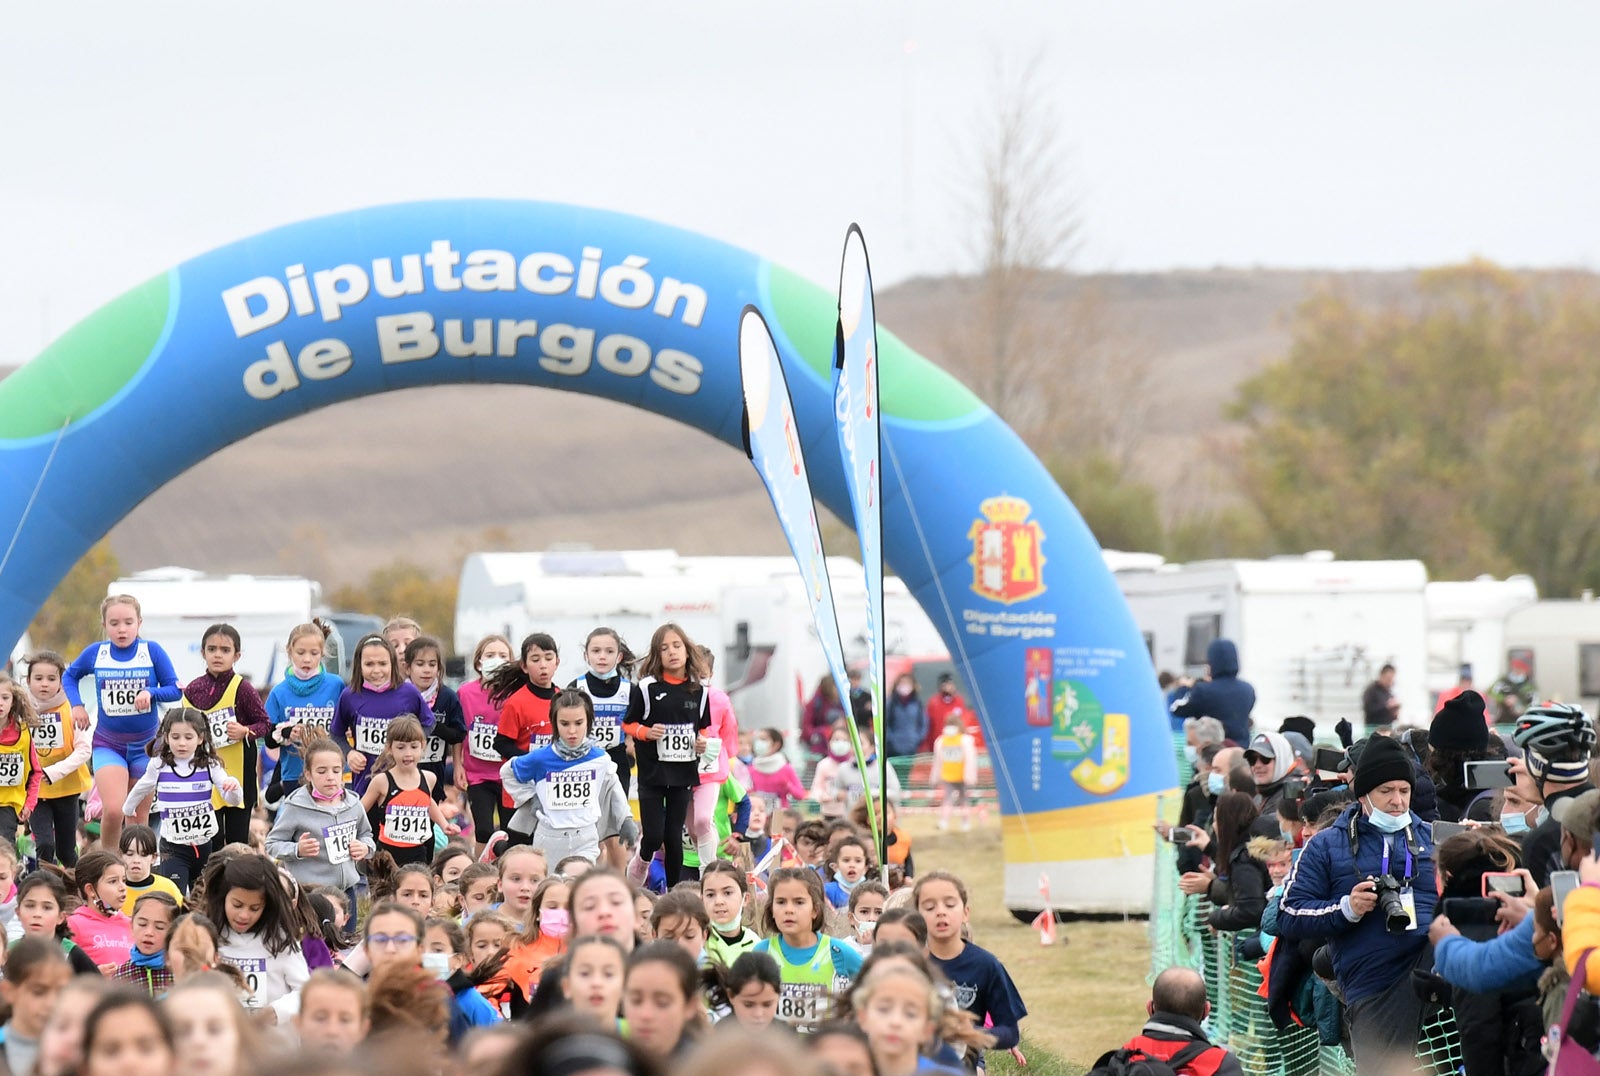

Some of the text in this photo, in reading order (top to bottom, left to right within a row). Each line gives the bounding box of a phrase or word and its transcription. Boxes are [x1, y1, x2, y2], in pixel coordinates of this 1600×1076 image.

[220, 239, 708, 338] Diputación
[242, 311, 704, 400] de Burgos
[963, 609, 1057, 625] Diputación
[966, 624, 1055, 640] de Burgos
[107, 690, 142, 705] 166
[550, 770, 592, 778] DIPUTACIÓN
[552, 782, 591, 799] 1858
[168, 801, 209, 814] DIPUTACIÓN
[168, 807, 211, 819] BURGOS
[391, 805, 429, 813] DIPUTACIÓN
[171, 814, 212, 834] 1942
[391, 815, 428, 833] 1914
